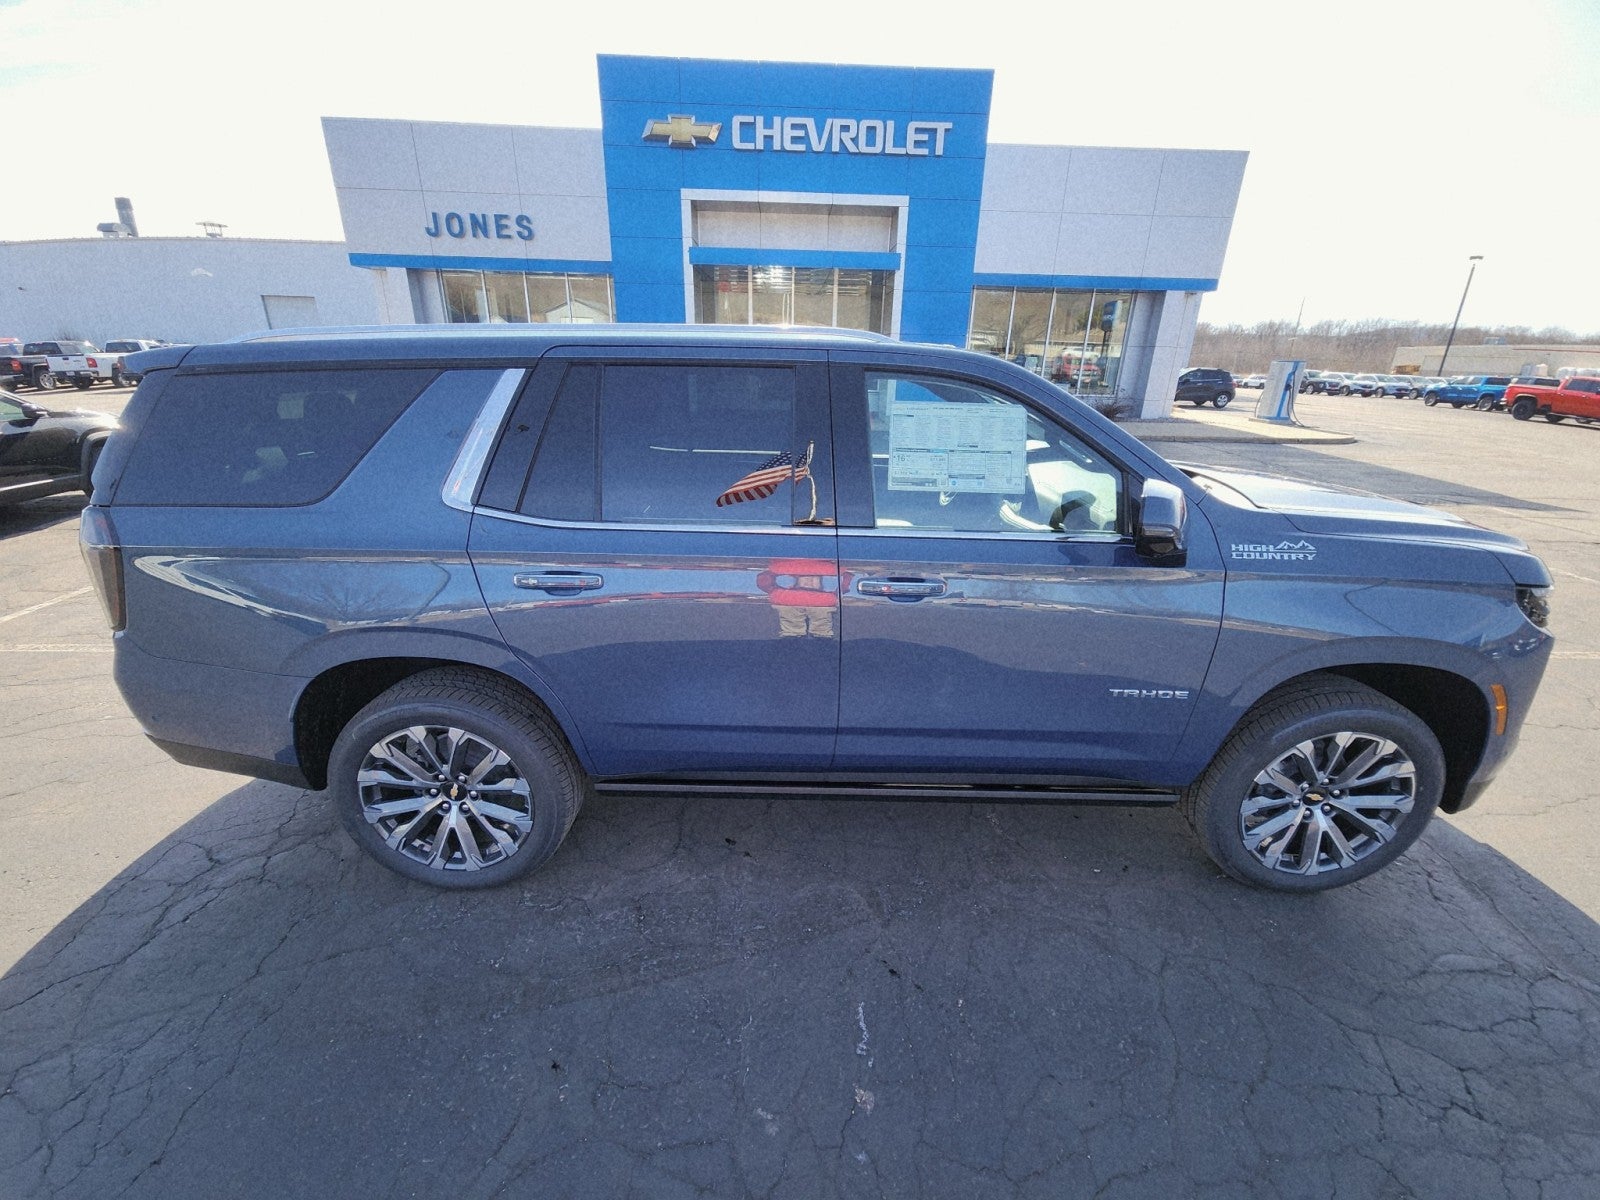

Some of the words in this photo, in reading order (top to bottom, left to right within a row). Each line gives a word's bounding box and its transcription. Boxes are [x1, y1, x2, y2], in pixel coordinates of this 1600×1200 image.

[731, 114, 953, 156] CHEVROLET
[425, 211, 534, 241] JONES
[1231, 543, 1275, 552] HIGH
[1231, 552, 1317, 561] COUNTRY
[1109, 688, 1189, 699] TAHOE
